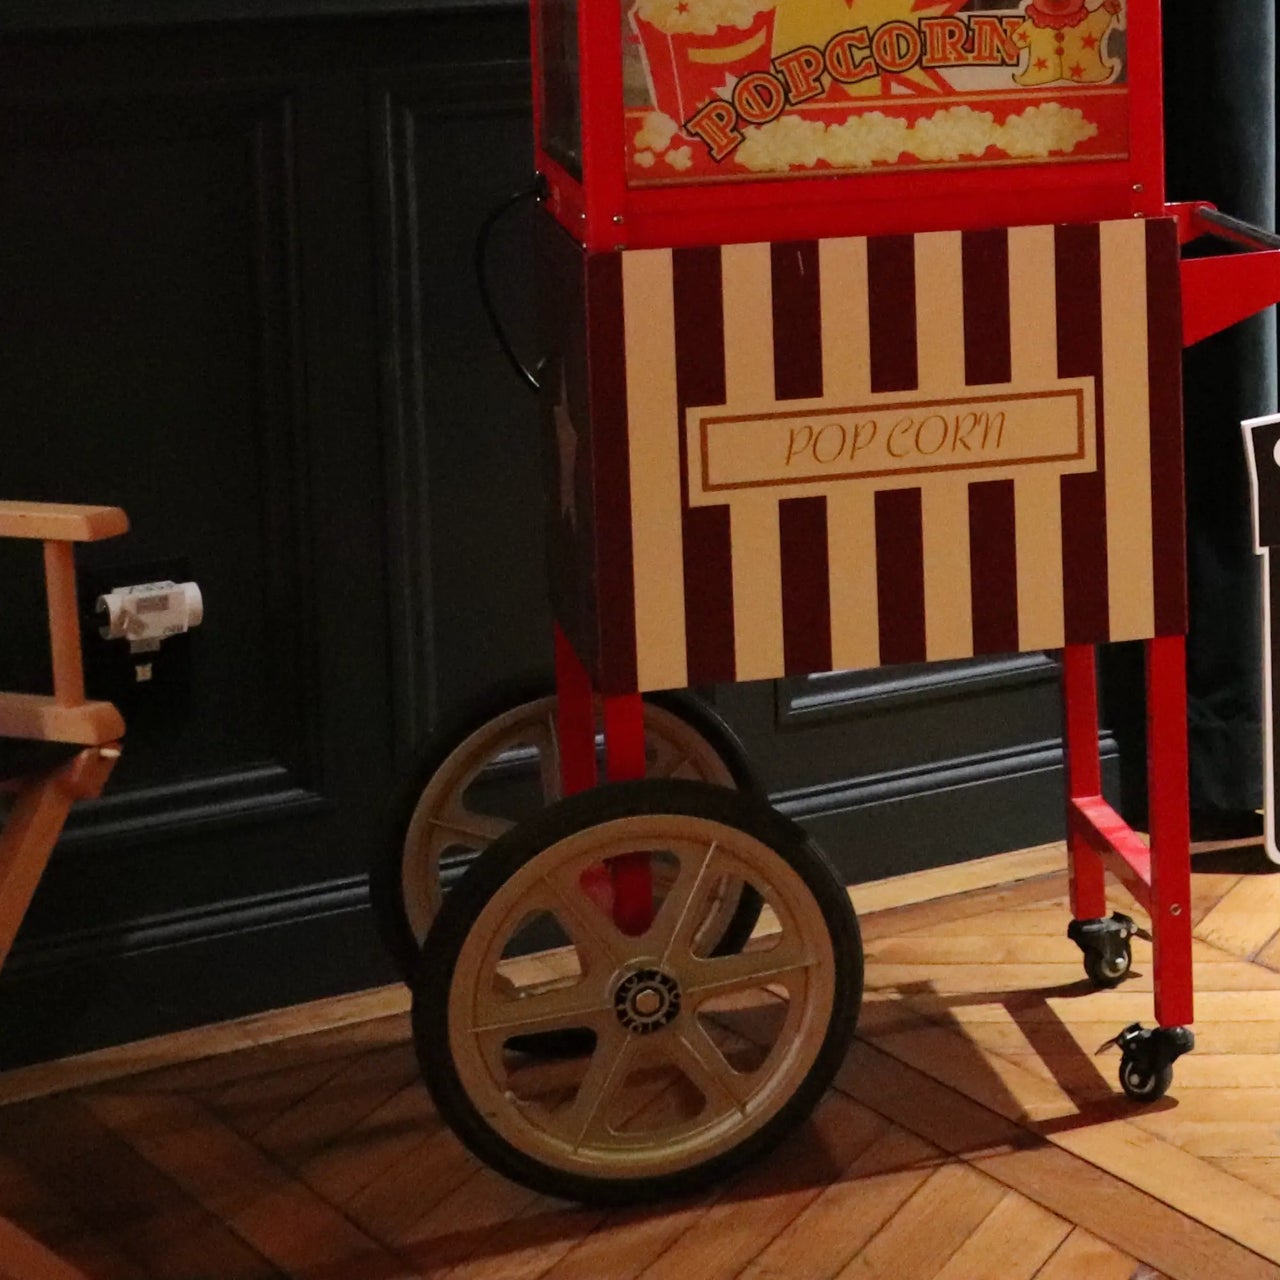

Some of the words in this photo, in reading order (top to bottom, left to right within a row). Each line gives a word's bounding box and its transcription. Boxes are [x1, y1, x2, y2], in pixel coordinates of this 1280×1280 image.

[685, 16, 1026, 161] POPCORN
[785, 419, 877, 466] POP
[886, 411, 1006, 458] CORN
